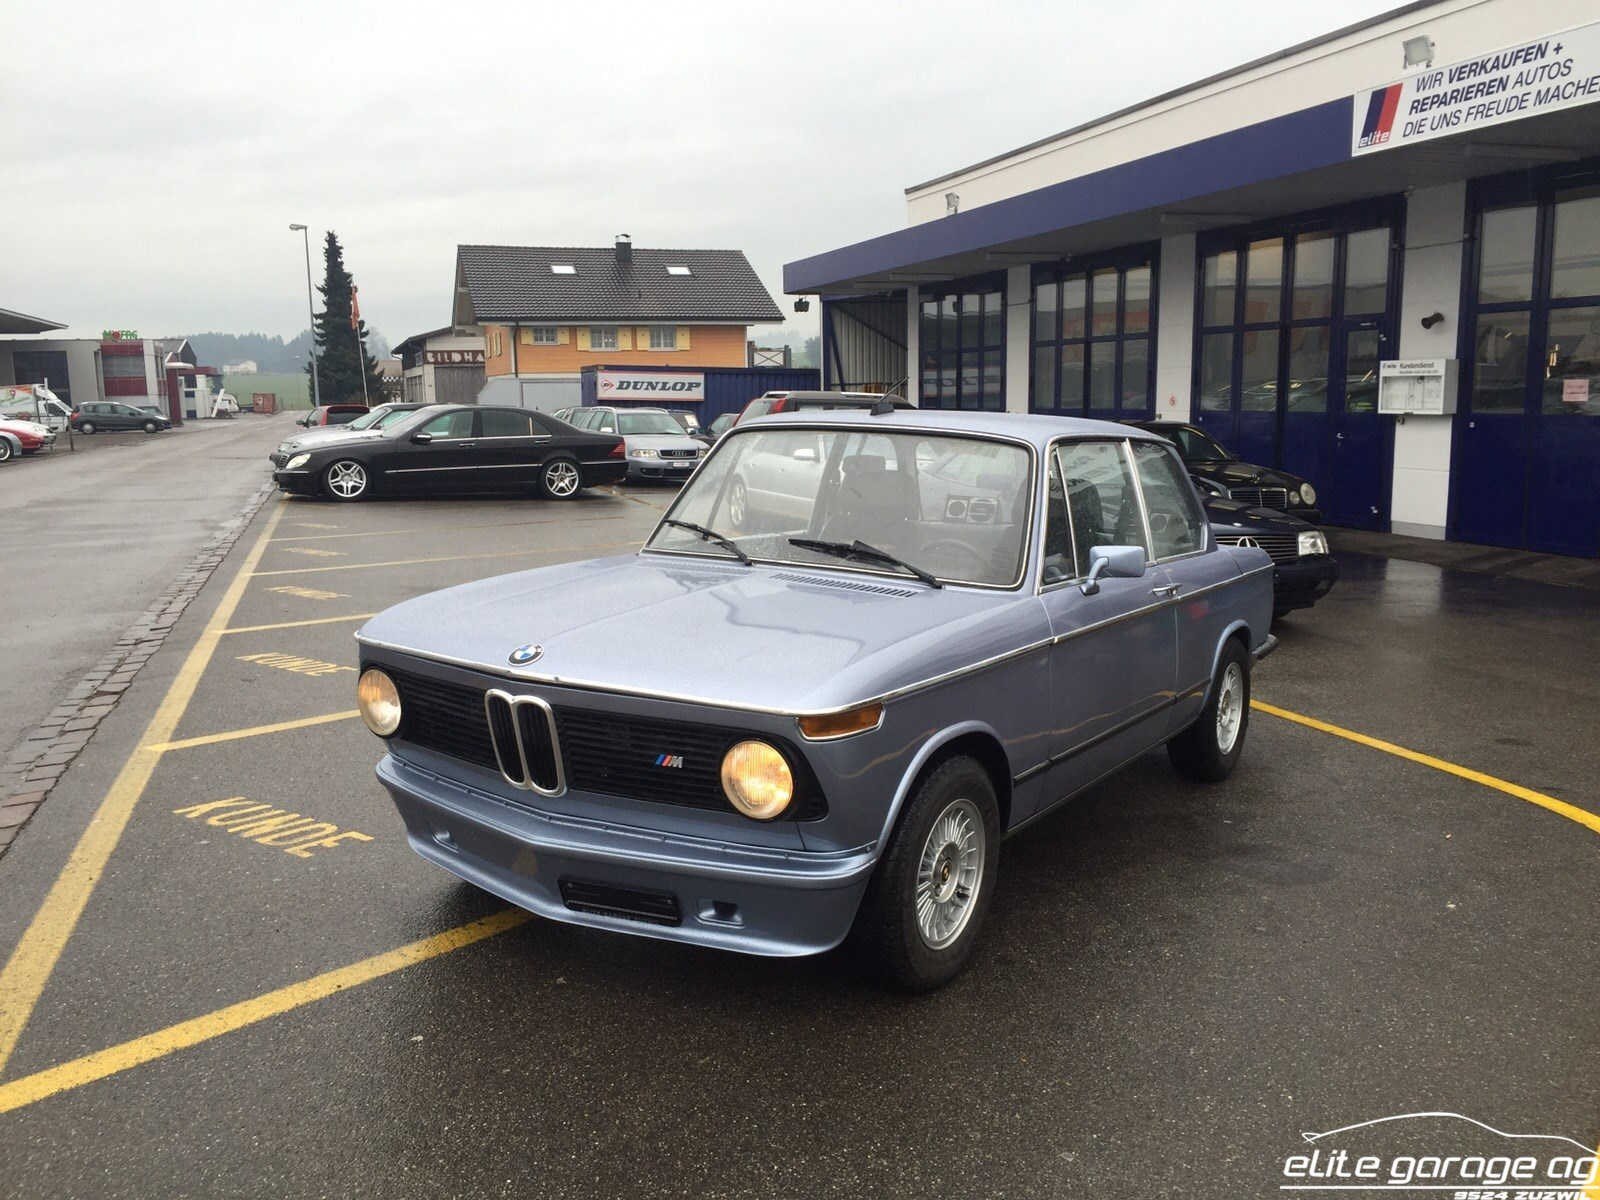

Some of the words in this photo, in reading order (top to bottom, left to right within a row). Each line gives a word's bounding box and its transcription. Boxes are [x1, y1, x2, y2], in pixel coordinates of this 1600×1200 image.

[1408, 75, 1510, 116] REPARIEREN
[1511, 58, 1574, 90] AUTOS
[1416, 70, 1445, 93] WIR
[1447, 40, 1550, 85] VERKAUFEN
[1552, 42, 1564, 56] +
[1402, 116, 1426, 138] DIE
[1430, 109, 1462, 131] UNS
[1464, 92, 1530, 123] FREUDE
[1532, 74, 1600, 107] MACHE
[1358, 129, 1391, 149] elite
[616, 379, 702, 392] DUNLOP
[172, 796, 375, 859] KUNDE
